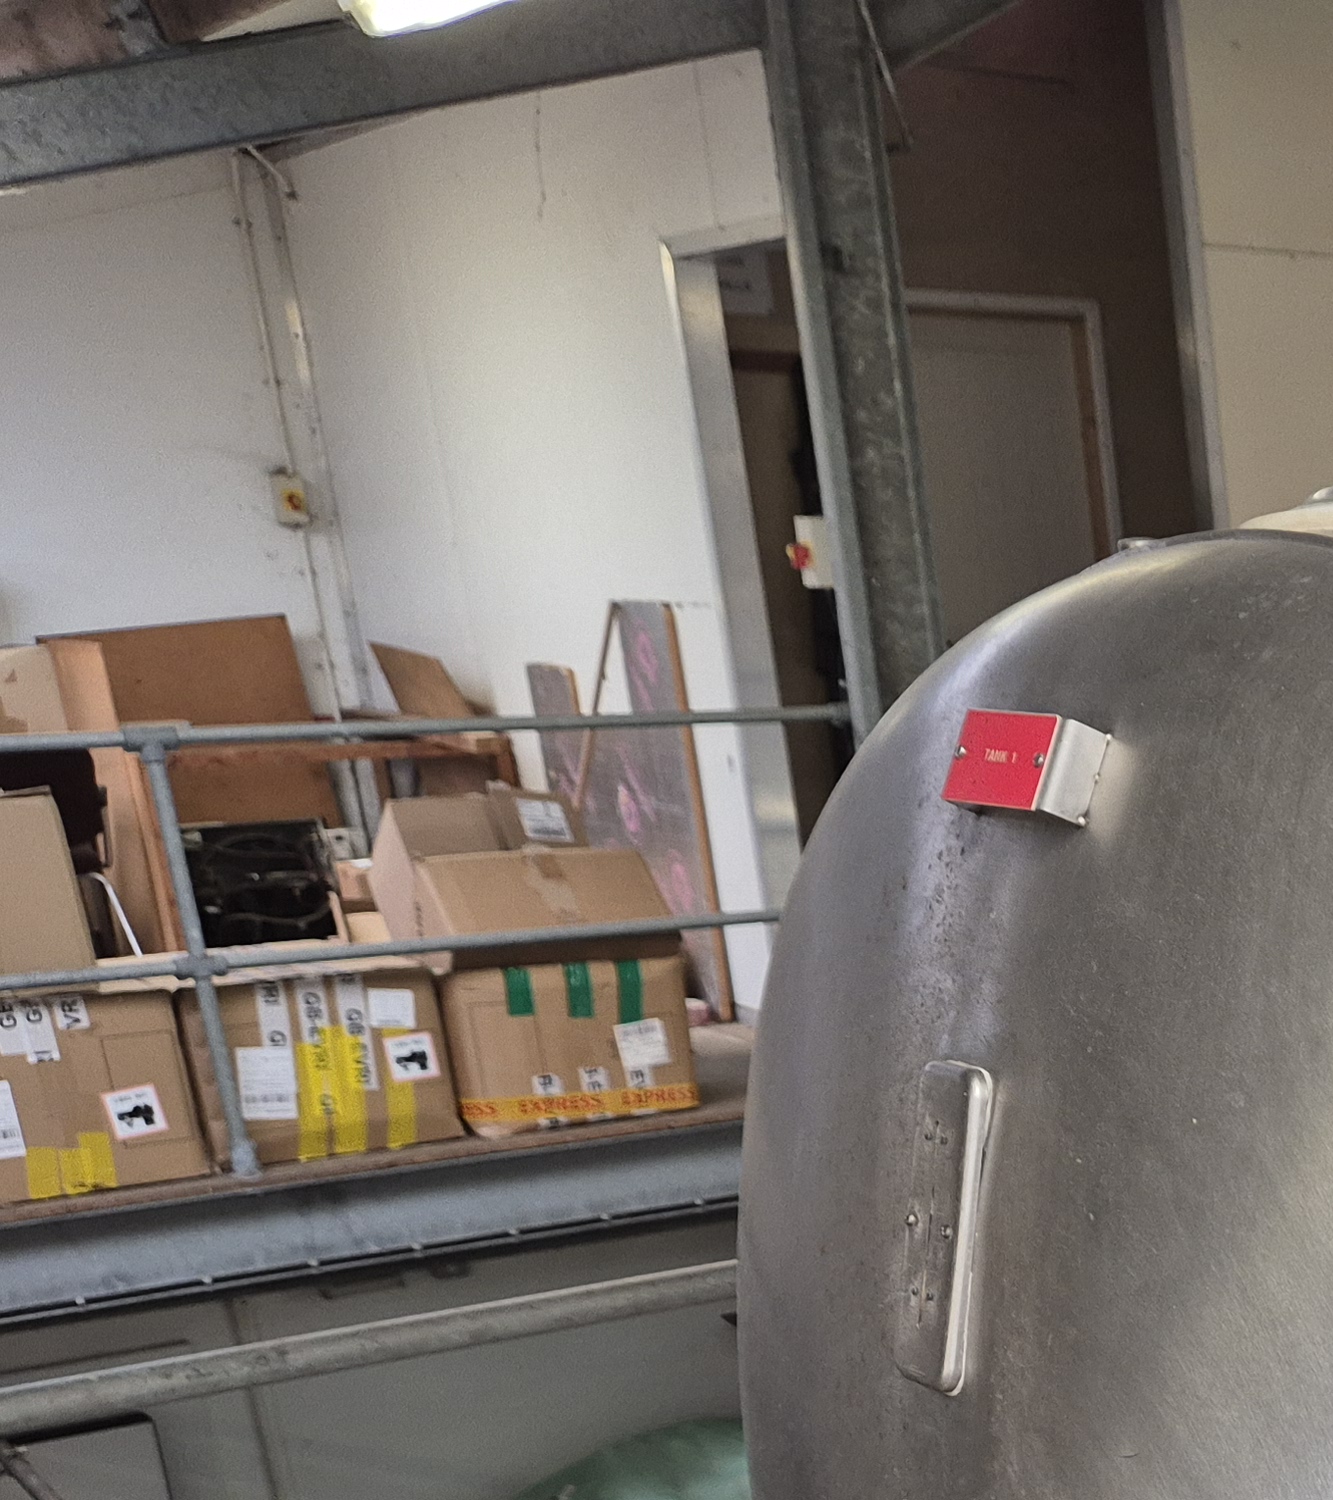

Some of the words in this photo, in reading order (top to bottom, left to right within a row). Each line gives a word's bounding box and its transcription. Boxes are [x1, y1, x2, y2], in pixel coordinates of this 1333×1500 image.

[984, 748, 1008, 764] TANK
[1011, 751, 1017, 764] 1
[519, 1093, 604, 1114] EXPRESS
